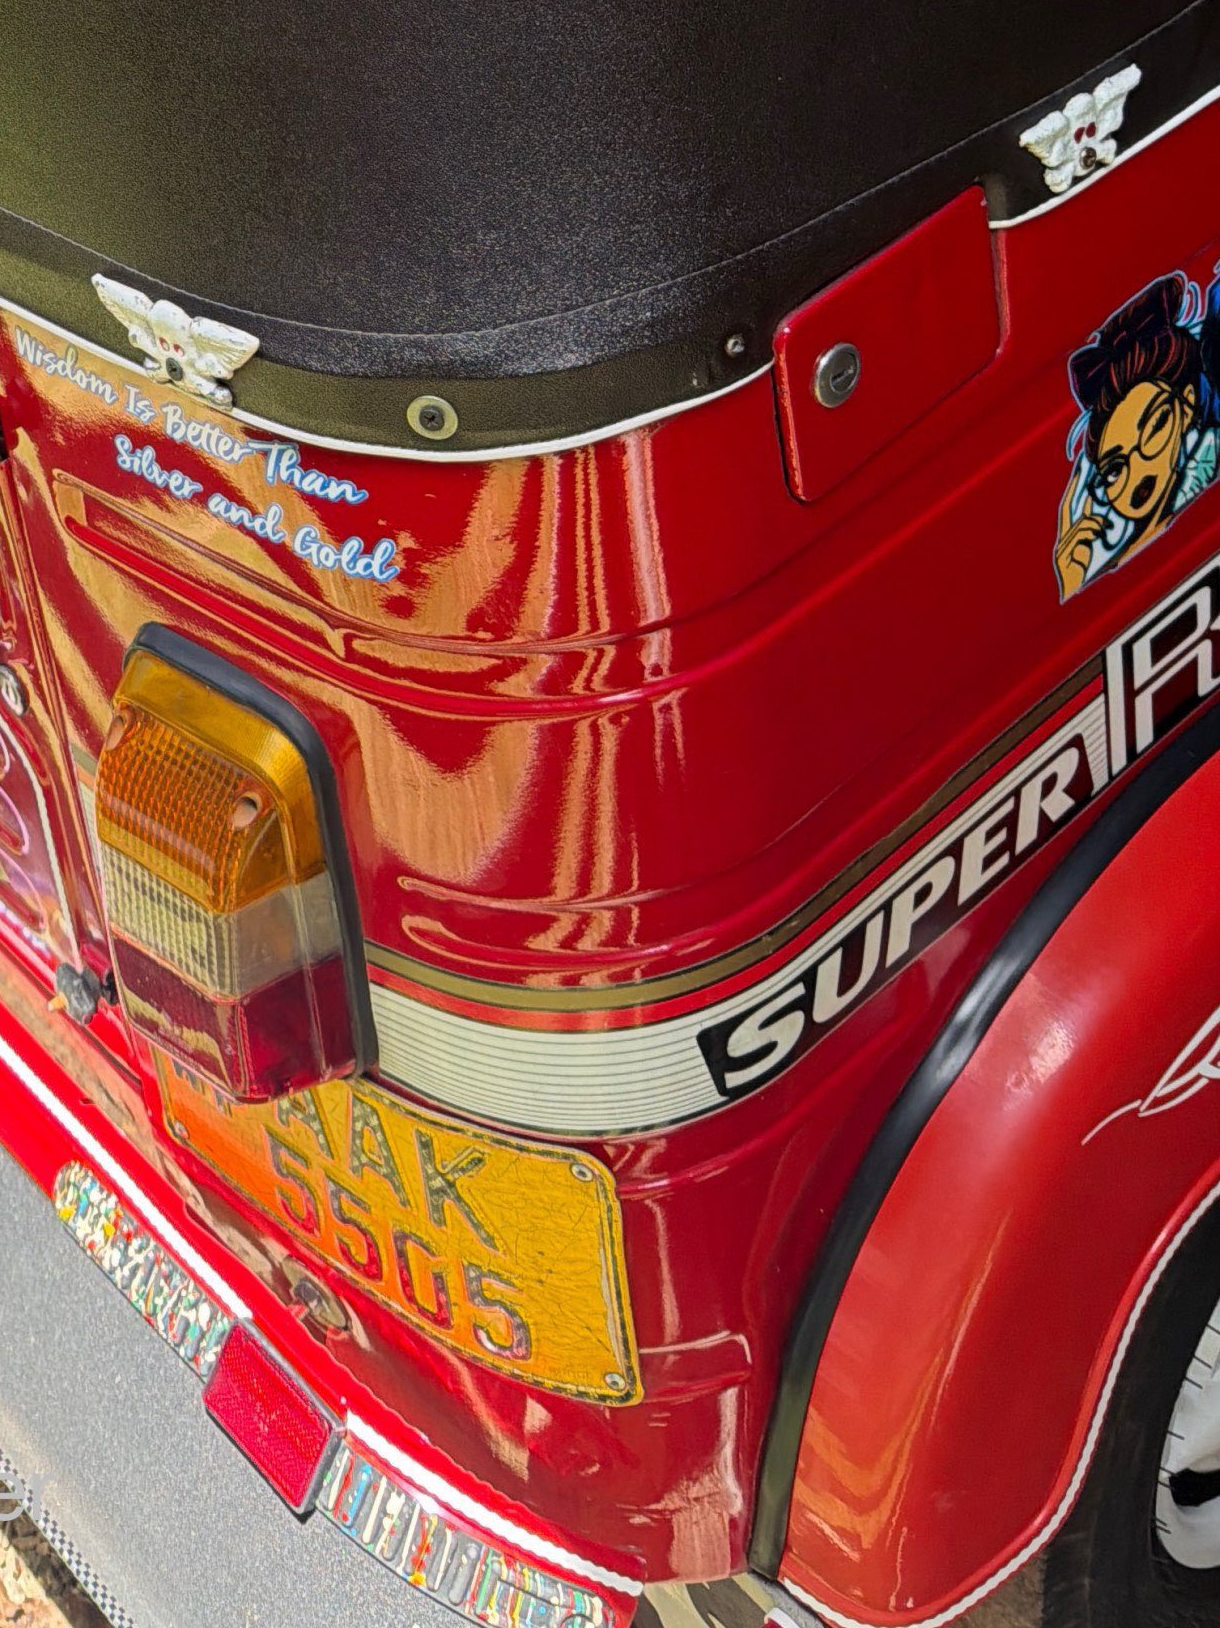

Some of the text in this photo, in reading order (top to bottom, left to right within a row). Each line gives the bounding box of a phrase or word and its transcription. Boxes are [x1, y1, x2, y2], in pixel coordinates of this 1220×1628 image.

[14, 326, 369, 505] Wisdom Is Better Than
[114, 434, 401, 583] Silver and Gold
[723, 744, 1081, 1090] SUPER
[262, 1124, 532, 1361] 5505
